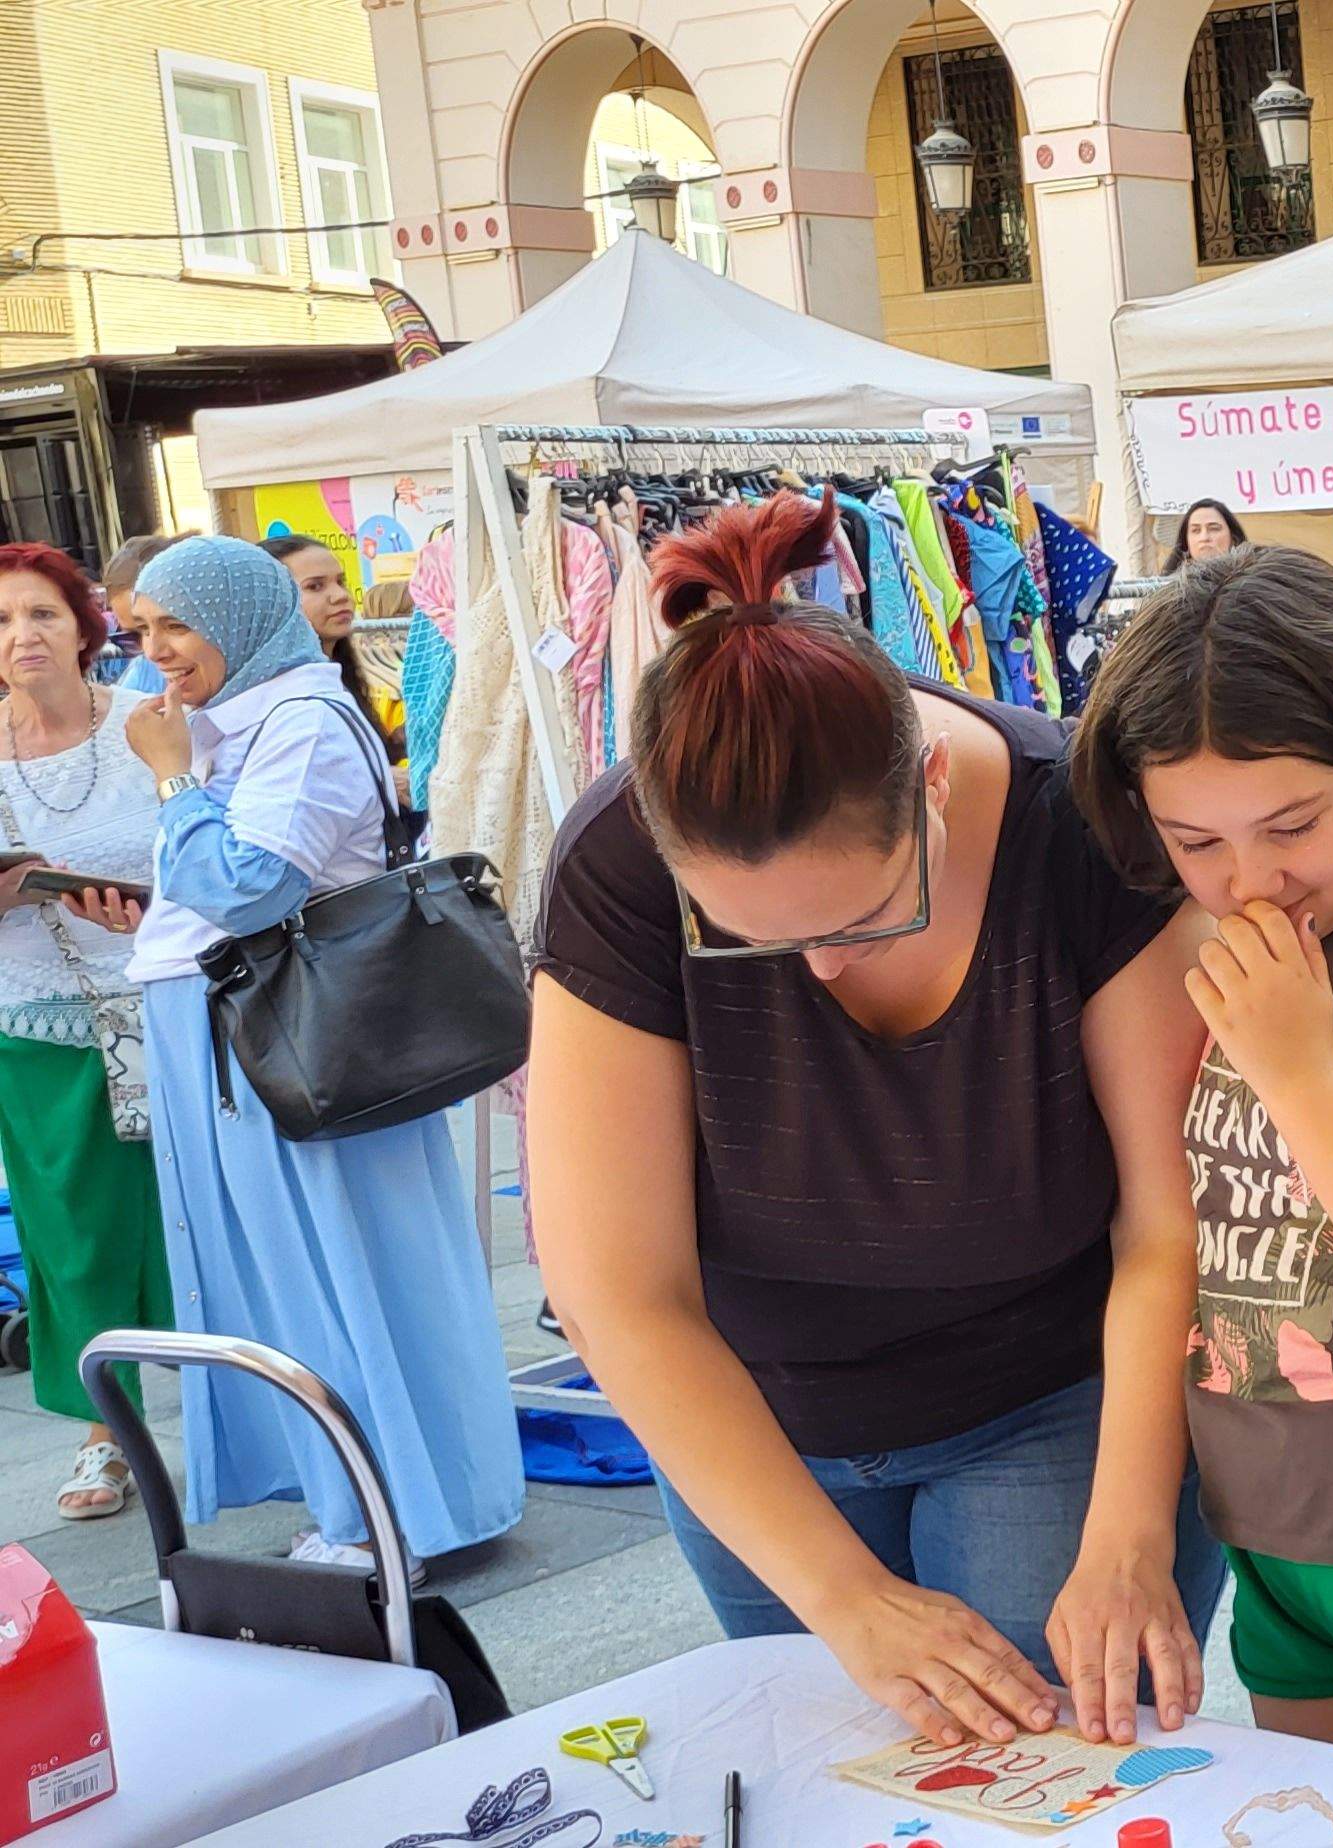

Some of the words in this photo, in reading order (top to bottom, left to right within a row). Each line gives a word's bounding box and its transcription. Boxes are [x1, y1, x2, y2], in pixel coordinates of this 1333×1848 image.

[1178, 395, 1322, 439] Súmate
[1235, 469, 1257, 505] y
[1197, 1219, 1308, 1283] NGLE
